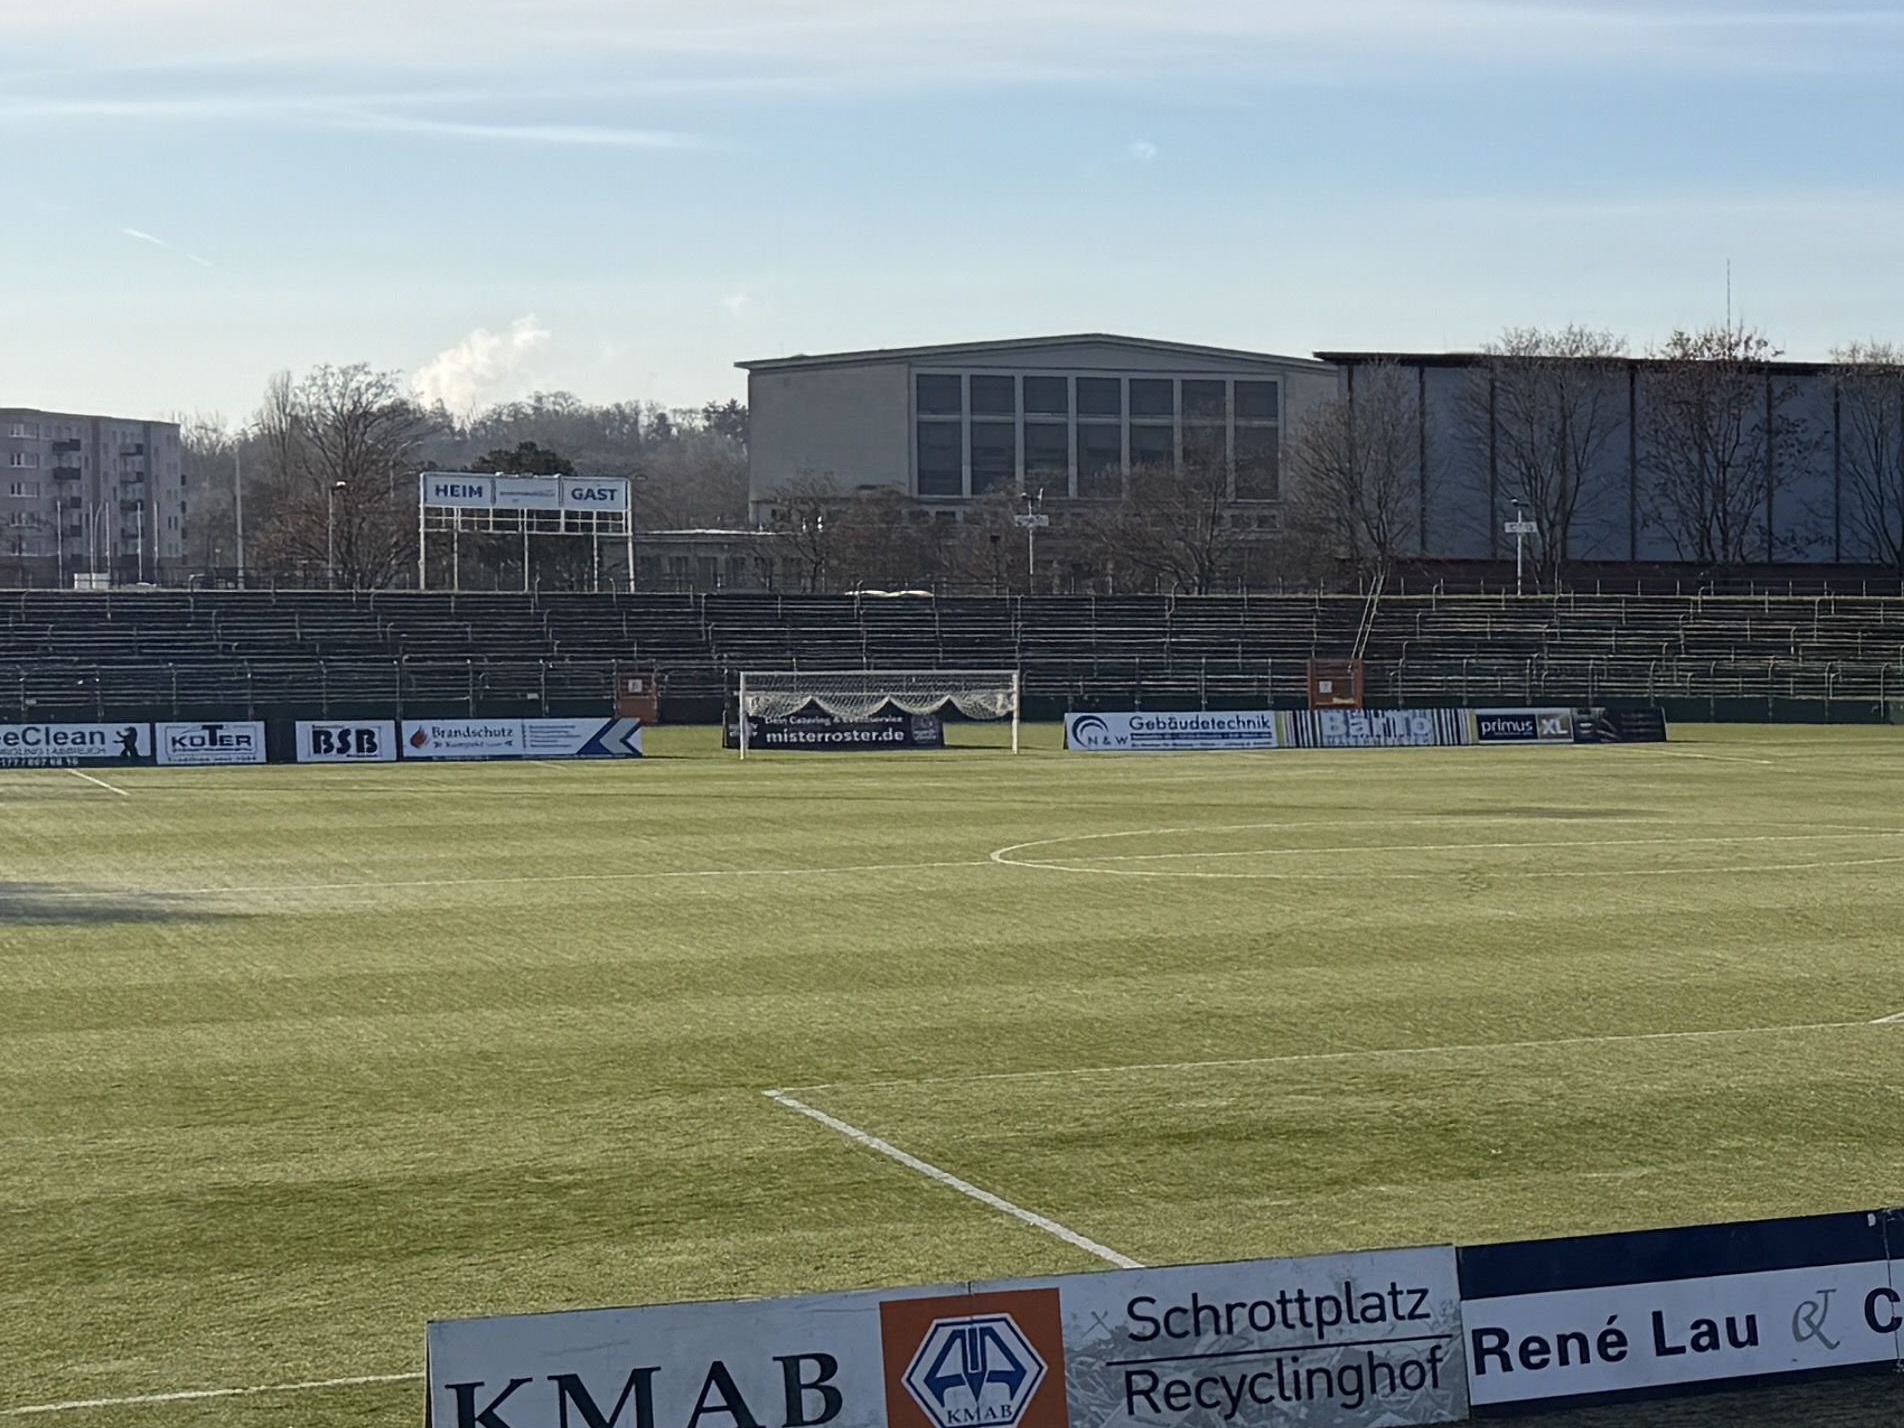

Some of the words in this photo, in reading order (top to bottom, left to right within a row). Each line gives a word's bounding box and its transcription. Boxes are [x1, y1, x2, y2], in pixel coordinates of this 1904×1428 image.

[435, 484, 483, 498] HEIM
[571, 487, 618, 501] GAST
[1129, 714, 1271, 731] Gebäudetechnik
[1481, 719, 1533, 736] primus
[1541, 718, 1569, 734] XL
[432, 725, 513, 739] Brandschutz
[766, 728, 905, 744] misterroster.de
[312, 728, 378, 754] BSB
[1087, 736, 1098, 746] N
[1116, 736, 1129, 746] W
[1126, 1280, 1431, 1342] Schrottplatz
[1471, 1314, 1629, 1376] René
[1651, 1310, 1760, 1357] Lau
[1790, 1288, 1841, 1351] &
[1126, 1344, 1444, 1420] Recyclinghof
[946, 1403, 1015, 1425] KMAB
